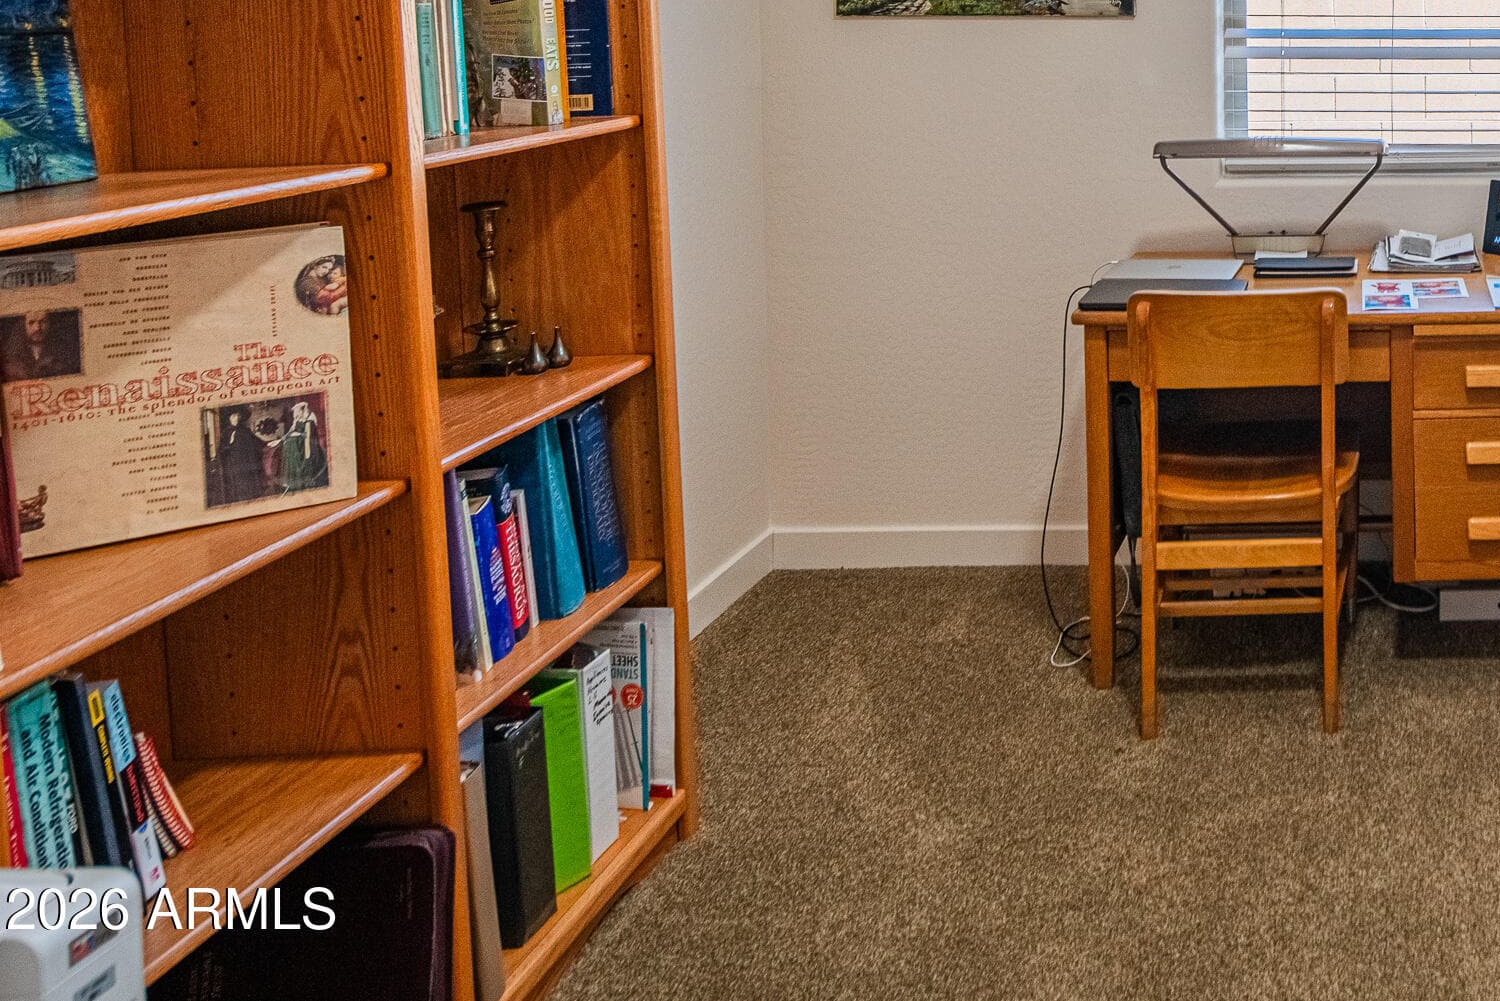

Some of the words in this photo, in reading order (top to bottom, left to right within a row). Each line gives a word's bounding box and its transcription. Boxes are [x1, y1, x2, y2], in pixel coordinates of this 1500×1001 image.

[547, 38, 560, 72] EATS
[233, 341, 287, 362] The
[10, 353, 340, 421] Renaissance
[12, 410, 103, 432] 1401-1610:
[107, 404, 137, 417] The
[142, 395, 214, 413] splendor
[219, 387, 234, 400] of
[506, 521, 527, 621] THESAURUS
[611, 655, 639, 667] SHEET
[611, 668, 639, 680] STAND
[21, 730, 36, 761] and
[111, 694, 131, 765] electronics
[26, 764, 39, 788] Air
[40, 713, 54, 777] Modern
[47, 776, 70, 869] Refrigeratio
